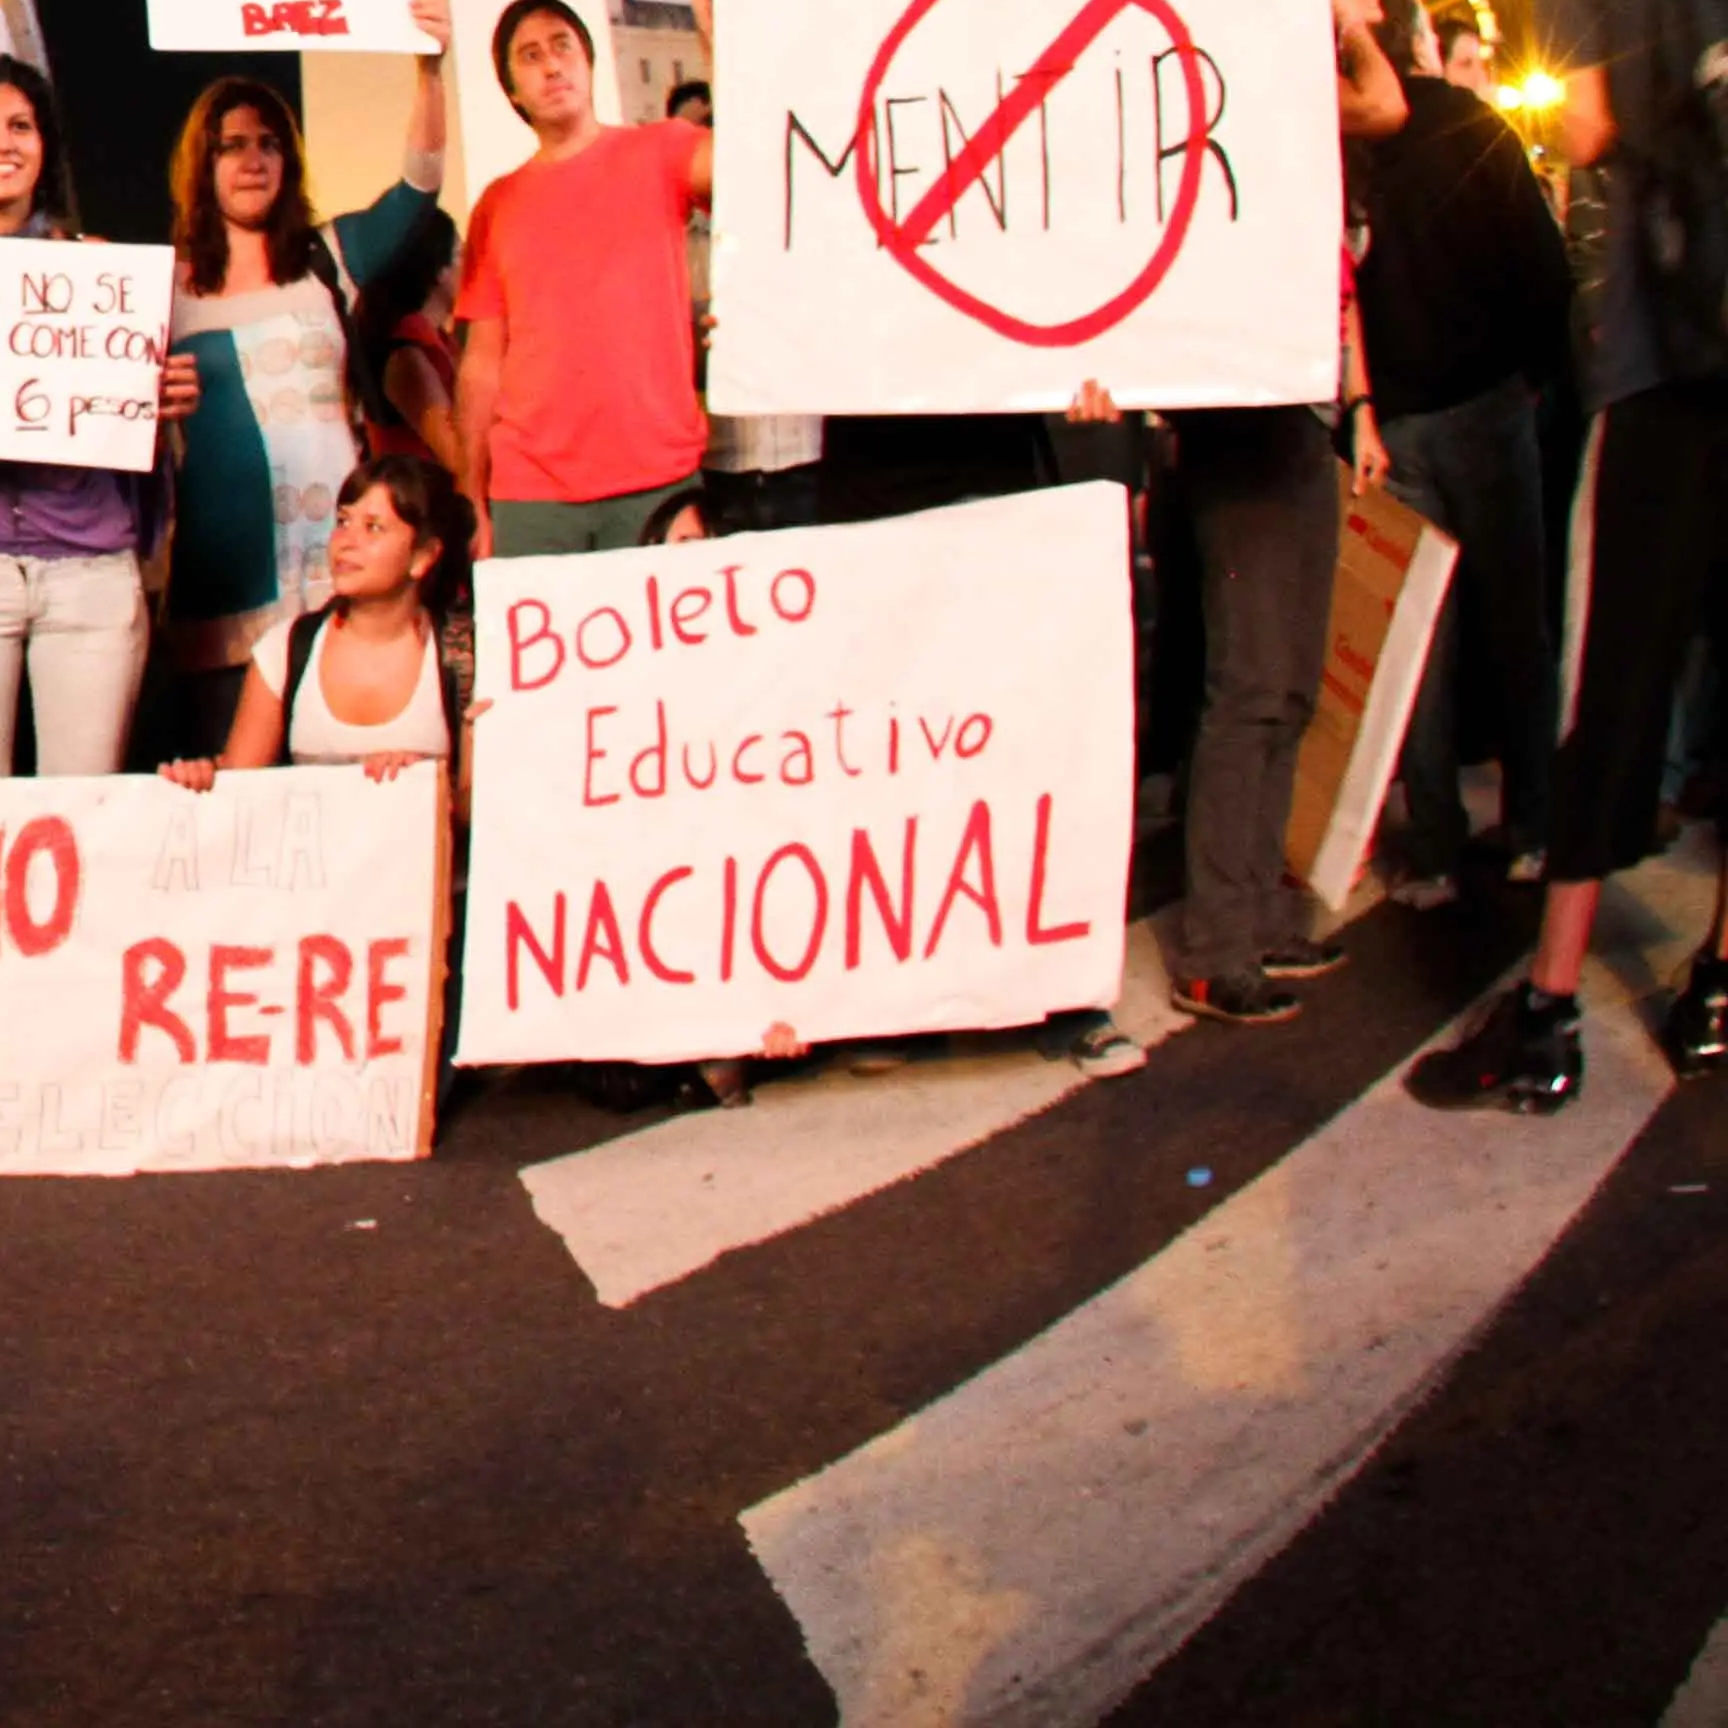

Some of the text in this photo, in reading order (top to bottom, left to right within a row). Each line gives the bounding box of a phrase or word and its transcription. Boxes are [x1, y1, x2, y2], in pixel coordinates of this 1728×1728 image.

[783, 43, 1240, 258] MENTIR
[8, 321, 166, 367] COME CON
[20, 271, 137, 316] NO SE
[14, 377, 53, 425] 6
[505, 563, 819, 694] Boleto
[580, 698, 995, 808] Educativo
[150, 798, 201, 893] A
[505, 793, 1091, 1013] NACIONAL
[116, 932, 412, 1069] RE-RE
